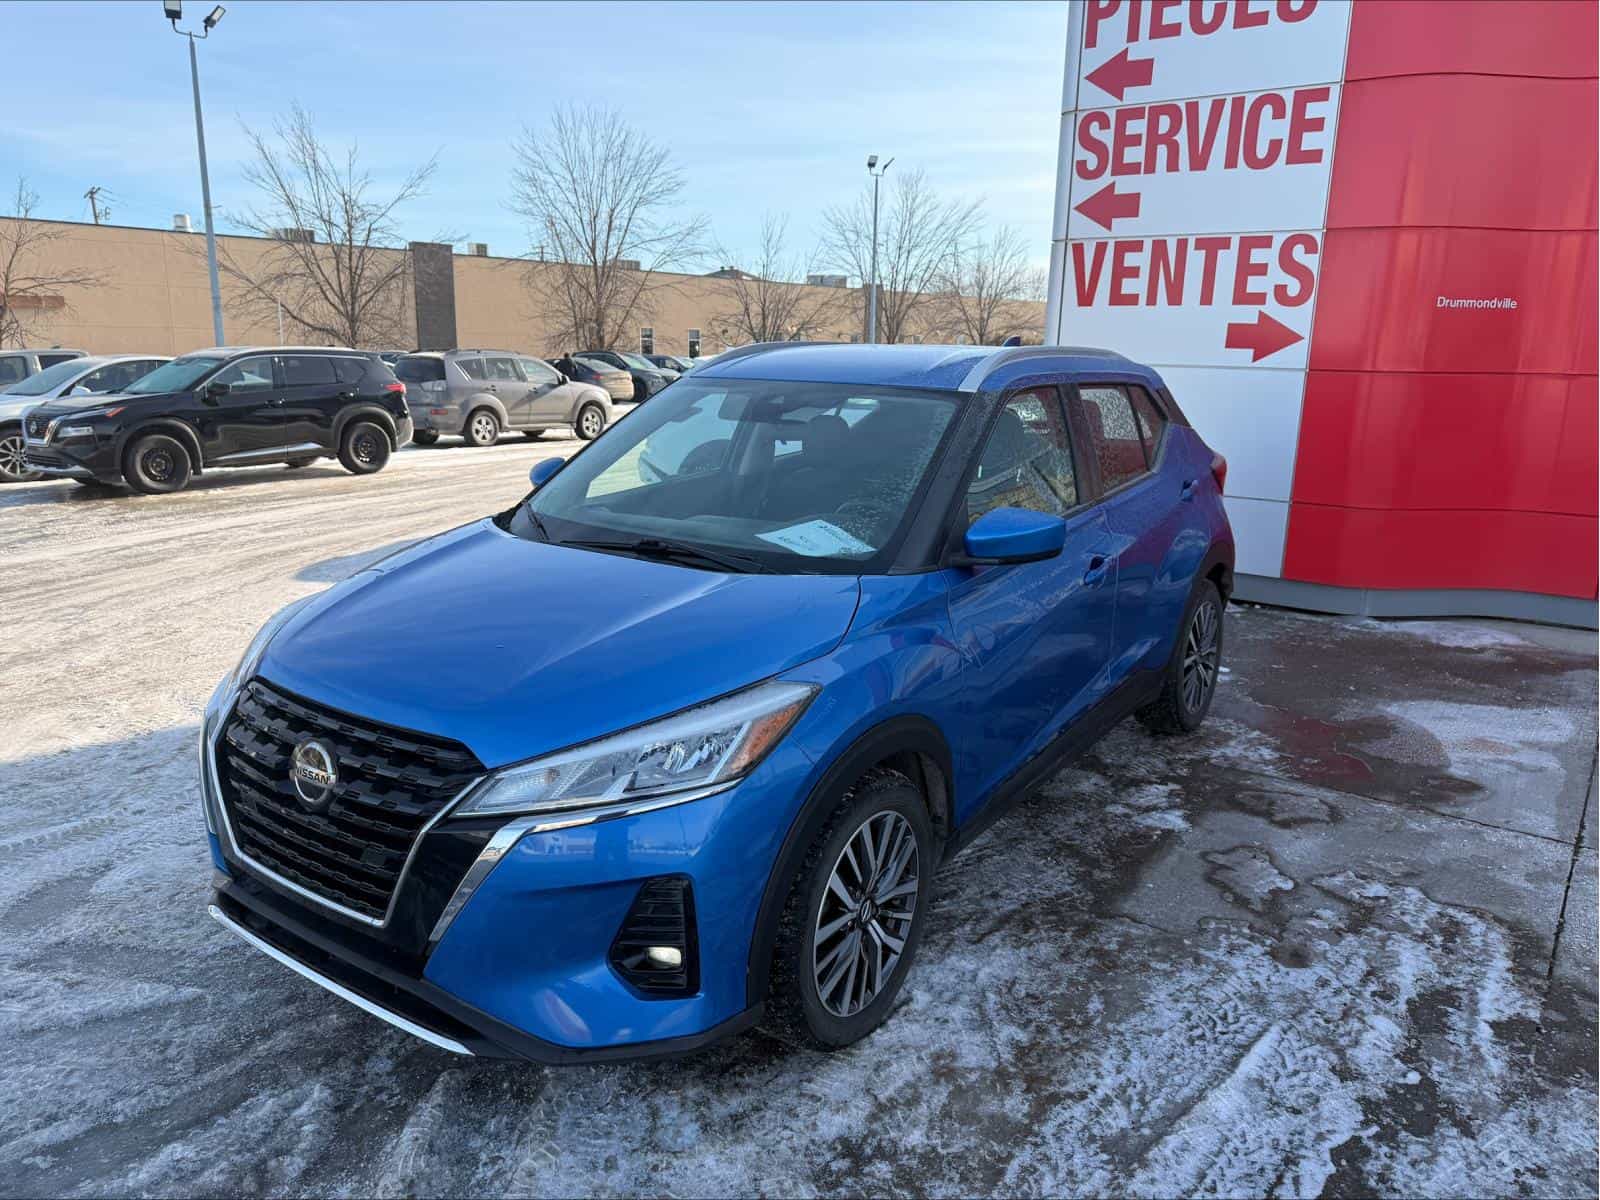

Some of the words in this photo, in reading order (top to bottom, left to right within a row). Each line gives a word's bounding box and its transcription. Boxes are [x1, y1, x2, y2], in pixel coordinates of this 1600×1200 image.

[1075, 87, 1330, 180] SERVICE
[1071, 233, 1319, 307] VENTES
[1437, 296, 1517, 309] Drummondville
